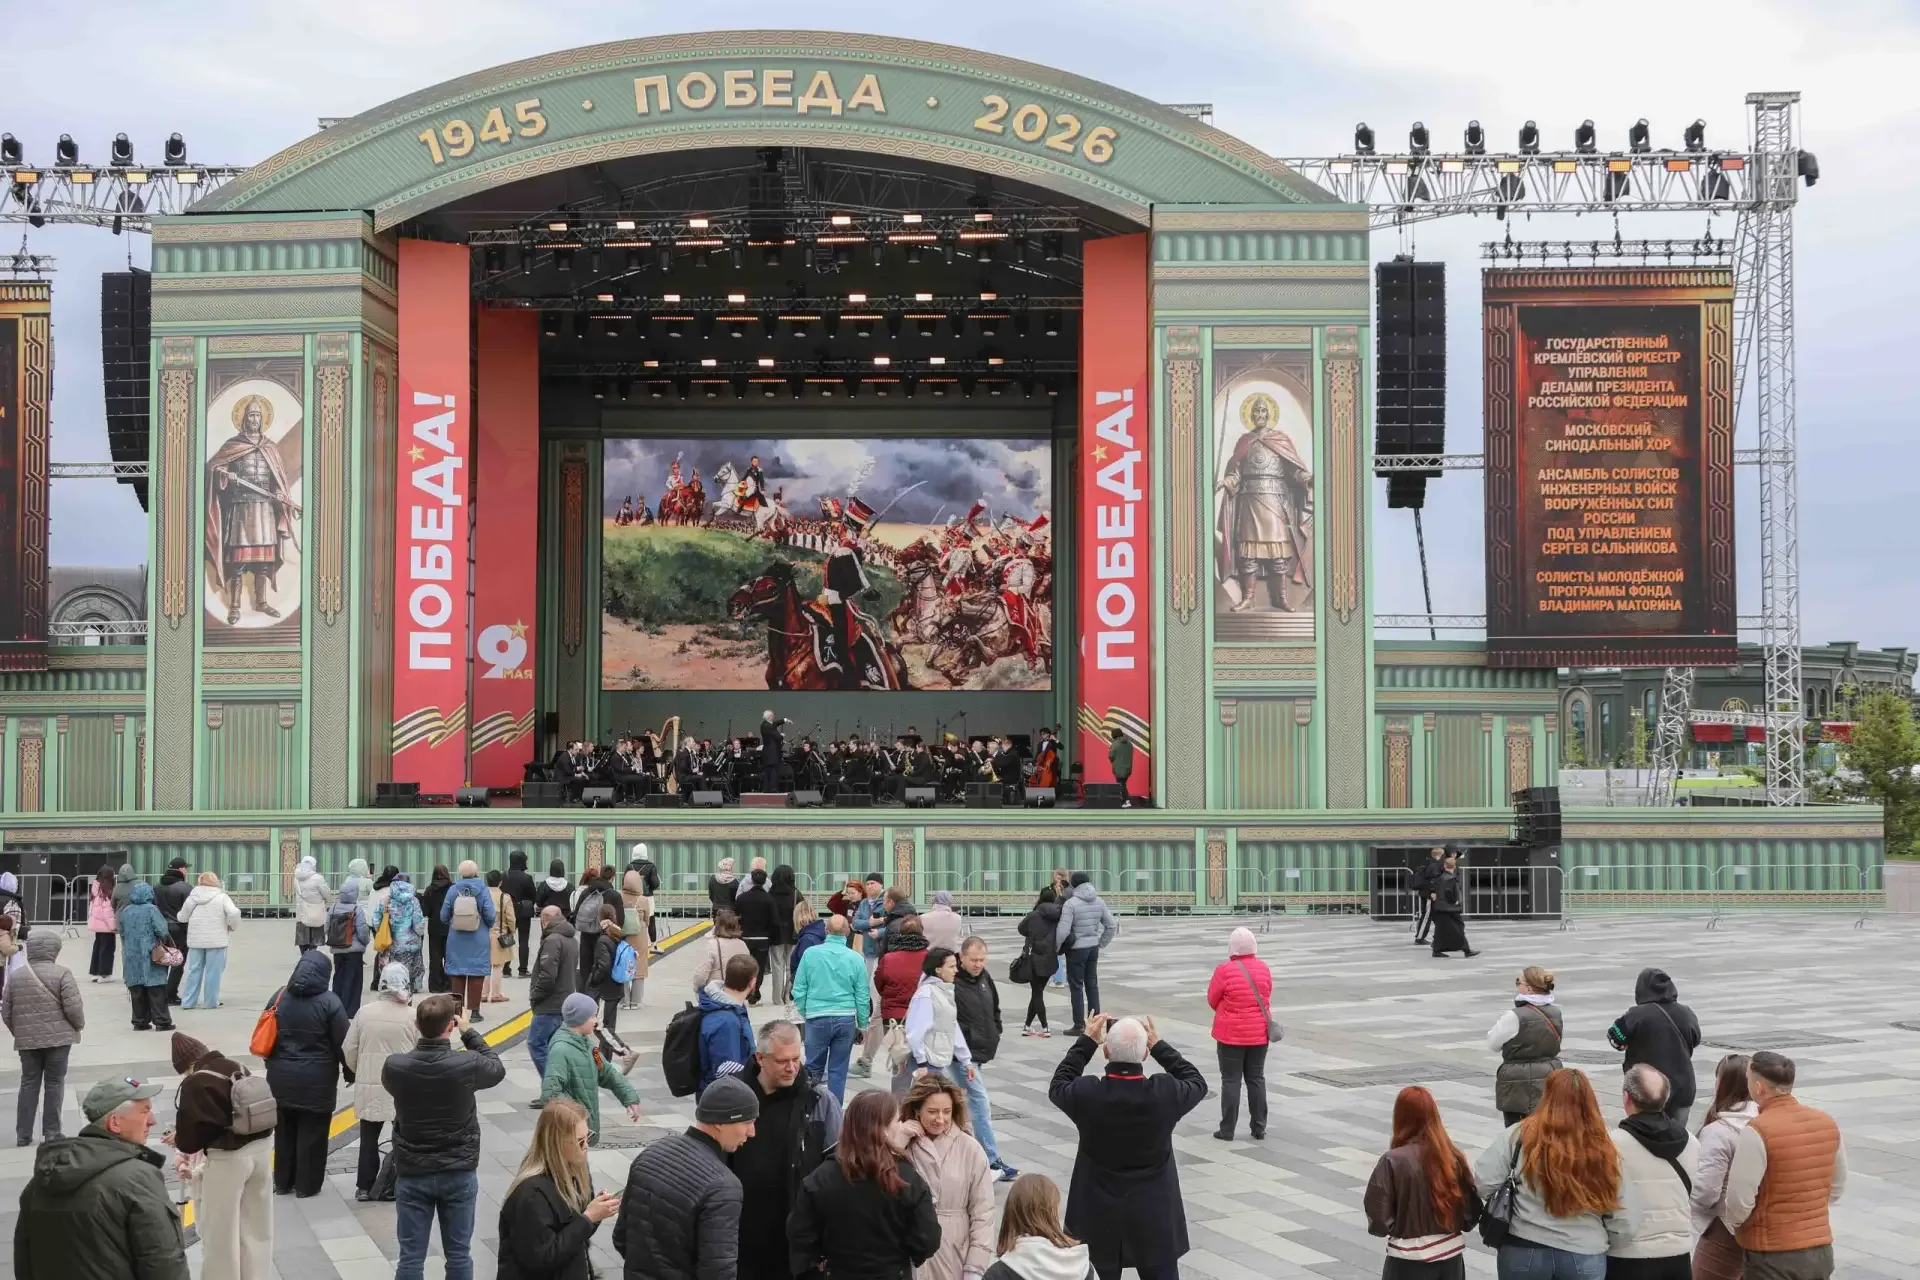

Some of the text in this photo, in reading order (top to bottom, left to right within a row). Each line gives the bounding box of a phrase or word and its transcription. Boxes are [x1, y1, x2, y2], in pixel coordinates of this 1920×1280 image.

[418, 69, 1118, 165] 1945 ПОБЕДА 2026
[1547, 335, 1668, 351] ГОСУДАРСТВЕННЫЙ
[1534, 350, 1681, 364] КРЕМЛЁВСКИЙ ОРКЕСТР
[1568, 366, 1648, 378] УПРАВЛЕНИЯ
[1541, 381, 1675, 395] ДЕЛАМИ ПРЕЗИДЕНТА
[1528, 394, 1688, 408] РОССИЙСКОЙ ФЕДЕРАЦИИ
[1565, 422, 1651, 437] МОСКОВСКИЙ
[1546, 437, 1672, 453] СИНОДАЛЬНЫЙ ХОР
[1538, 467, 1680, 481] АНСАМБЛЬ СОЛИСТОВ
[1541, 480, 1677, 495] ИНЖЕНЕРНЫХ ВОЙСК
[1545, 495, 1674, 510] ВООРУЖЁННЫХ СИЛ
[1584, 512, 1636, 524] РОССИИ
[409, 391, 463, 670] ПОБЕДА!
[1096, 388, 1142, 670] ПОБЕДА!
[1548, 527, 1672, 541] ПОД УПРАВЛЕНИЕМ
[1542, 541, 1678, 555] СЕРГЕЯ САЛЬНИКОВА
[1536, 569, 1684, 584] СОЛИСТЫ МОЛОДЁЖНОЙ
[1549, 585, 1673, 598] ПРОГРАММЫ ФОНДА
[1539, 599, 1683, 613] ВЛАДИМИРА МАТОРИНА
[477, 624, 533, 680] 9 МАЯ
